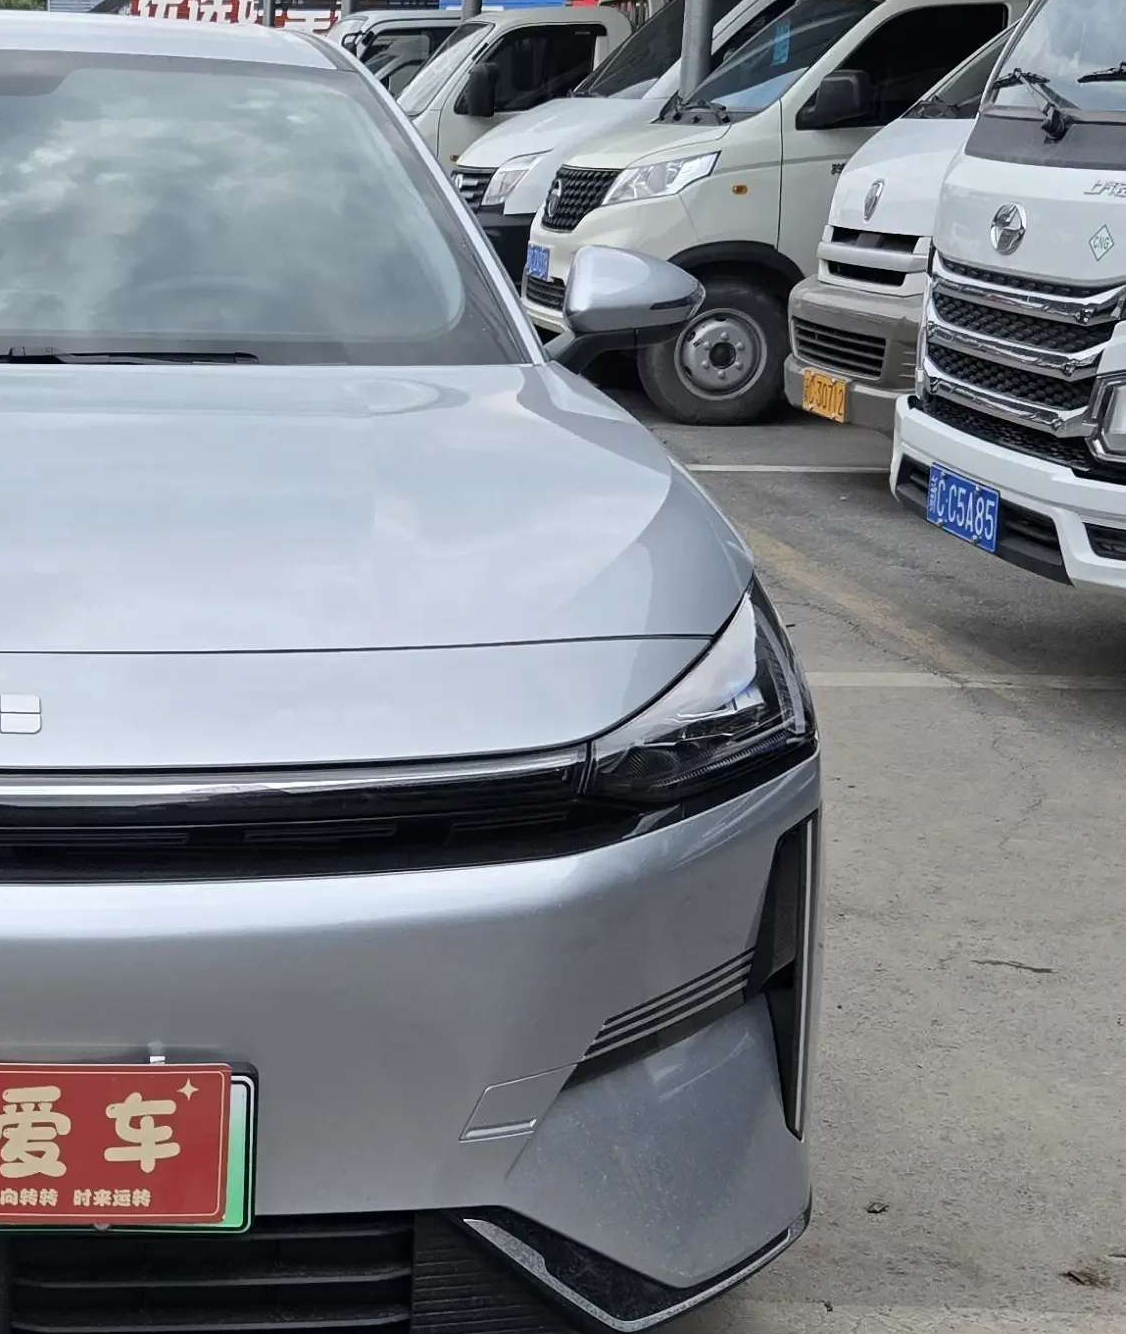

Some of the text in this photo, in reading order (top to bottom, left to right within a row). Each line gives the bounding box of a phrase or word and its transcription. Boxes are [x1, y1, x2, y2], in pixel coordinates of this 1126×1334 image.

[1093, 236, 1110, 250] CNG
[73, 1188, 151, 1207] 时来运转
